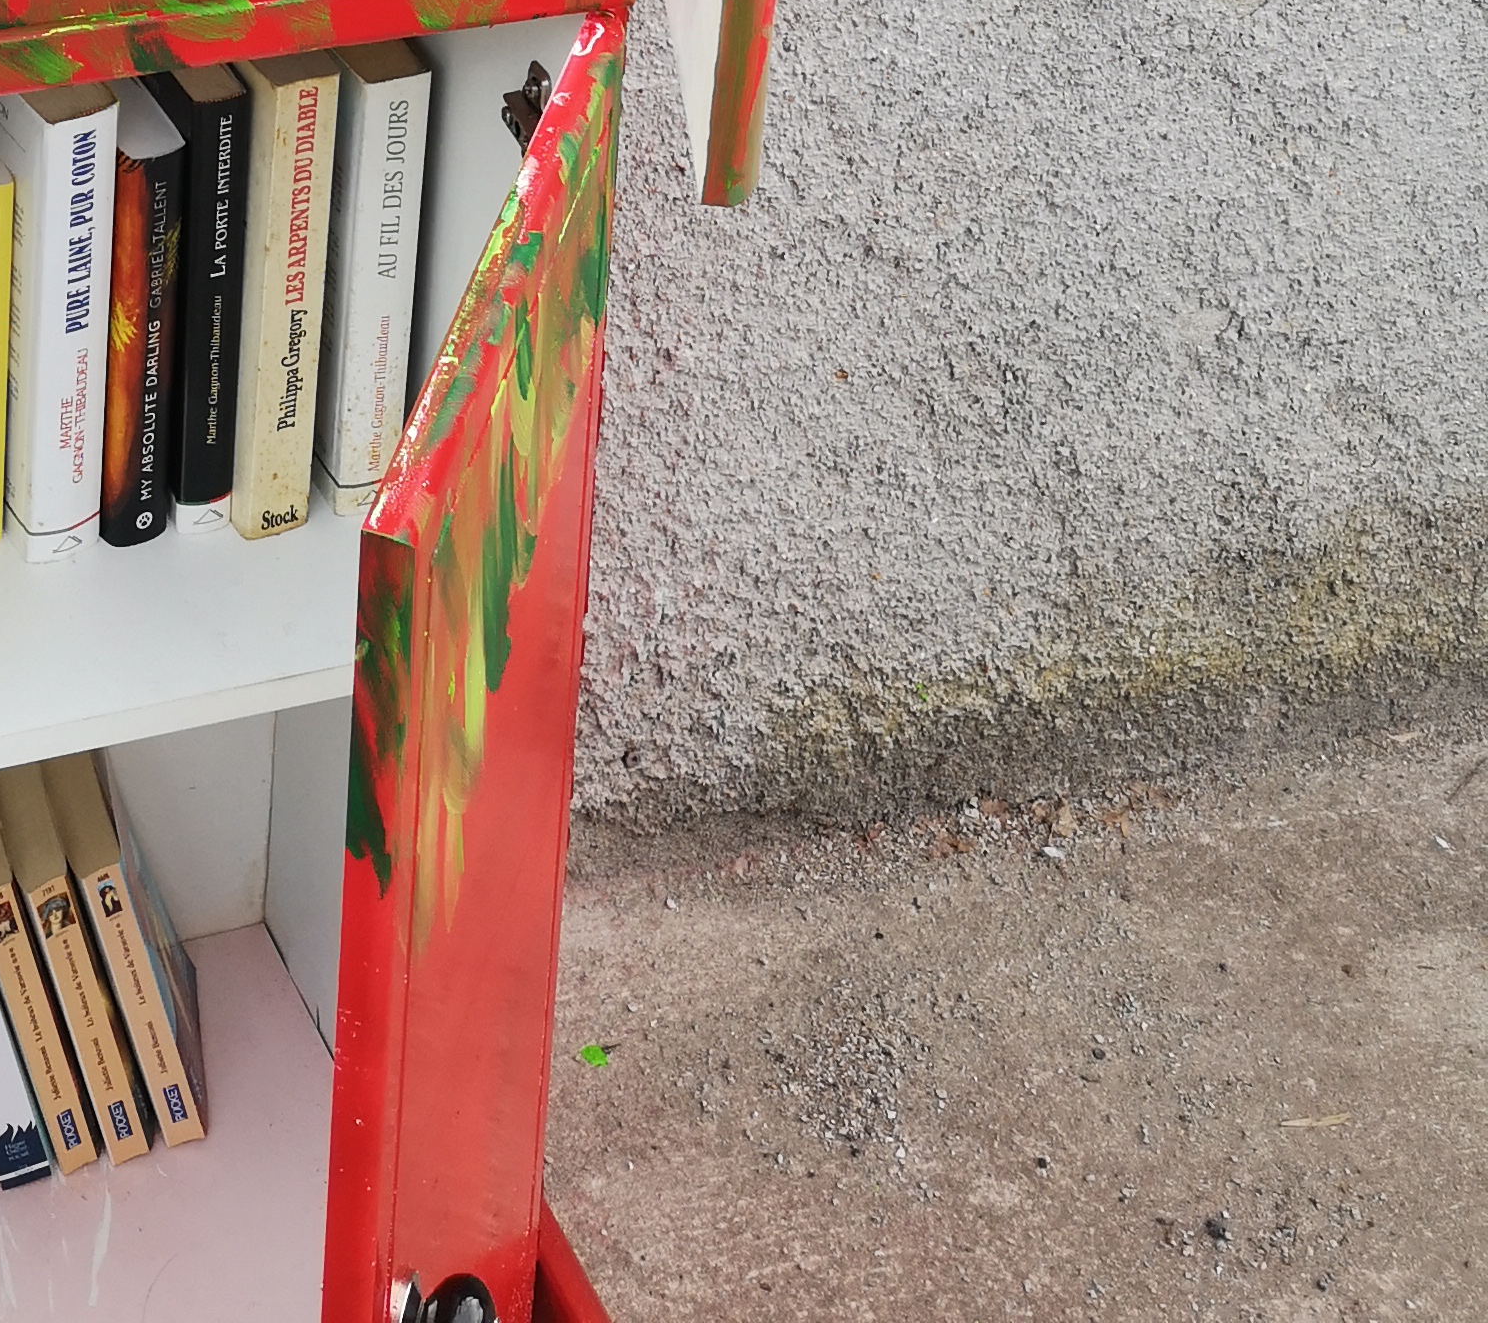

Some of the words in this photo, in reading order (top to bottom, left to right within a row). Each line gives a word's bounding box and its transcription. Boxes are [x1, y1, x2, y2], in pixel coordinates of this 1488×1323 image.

[293, 85, 319, 154] DIABLE
[384, 99, 409, 165] JOURS
[70, 128, 98, 186] COTON
[216, 113, 233, 195] INTERDITE
[291, 157, 313, 184] DU
[68, 187, 95, 226] PUR
[150, 180, 168, 244] TALLENT
[381, 169, 404, 210] DES
[213, 199, 230, 251] PORTE
[286, 185, 312, 269] ARPENTS
[378, 215, 401, 247] FIL
[66, 225, 96, 284] LAINE,
[149, 244, 166, 309] GABRIEL
[376, 251, 399, 280] AU
[64, 285, 92, 334] PURE
[283, 270, 305, 306] LES
[145, 320, 162, 387] DARLING
[279, 308, 308, 367] Gregory
[59, 395, 74, 450] MARTHE
[71, 347, 90, 484] GAGNON-THIBAUDEAU
[205, 407, 219, 445] Marthe
[275, 367, 304, 432] Philippa
[141, 391, 159, 474] ABSOLUTE
[139, 478, 154, 502] MY
[260, 504, 300, 532] Stock
[59, 1110, 78, 1149] POCKET
[111, 1102, 130, 1140] POCKET
[166, 1084, 186, 1123] POCKET
